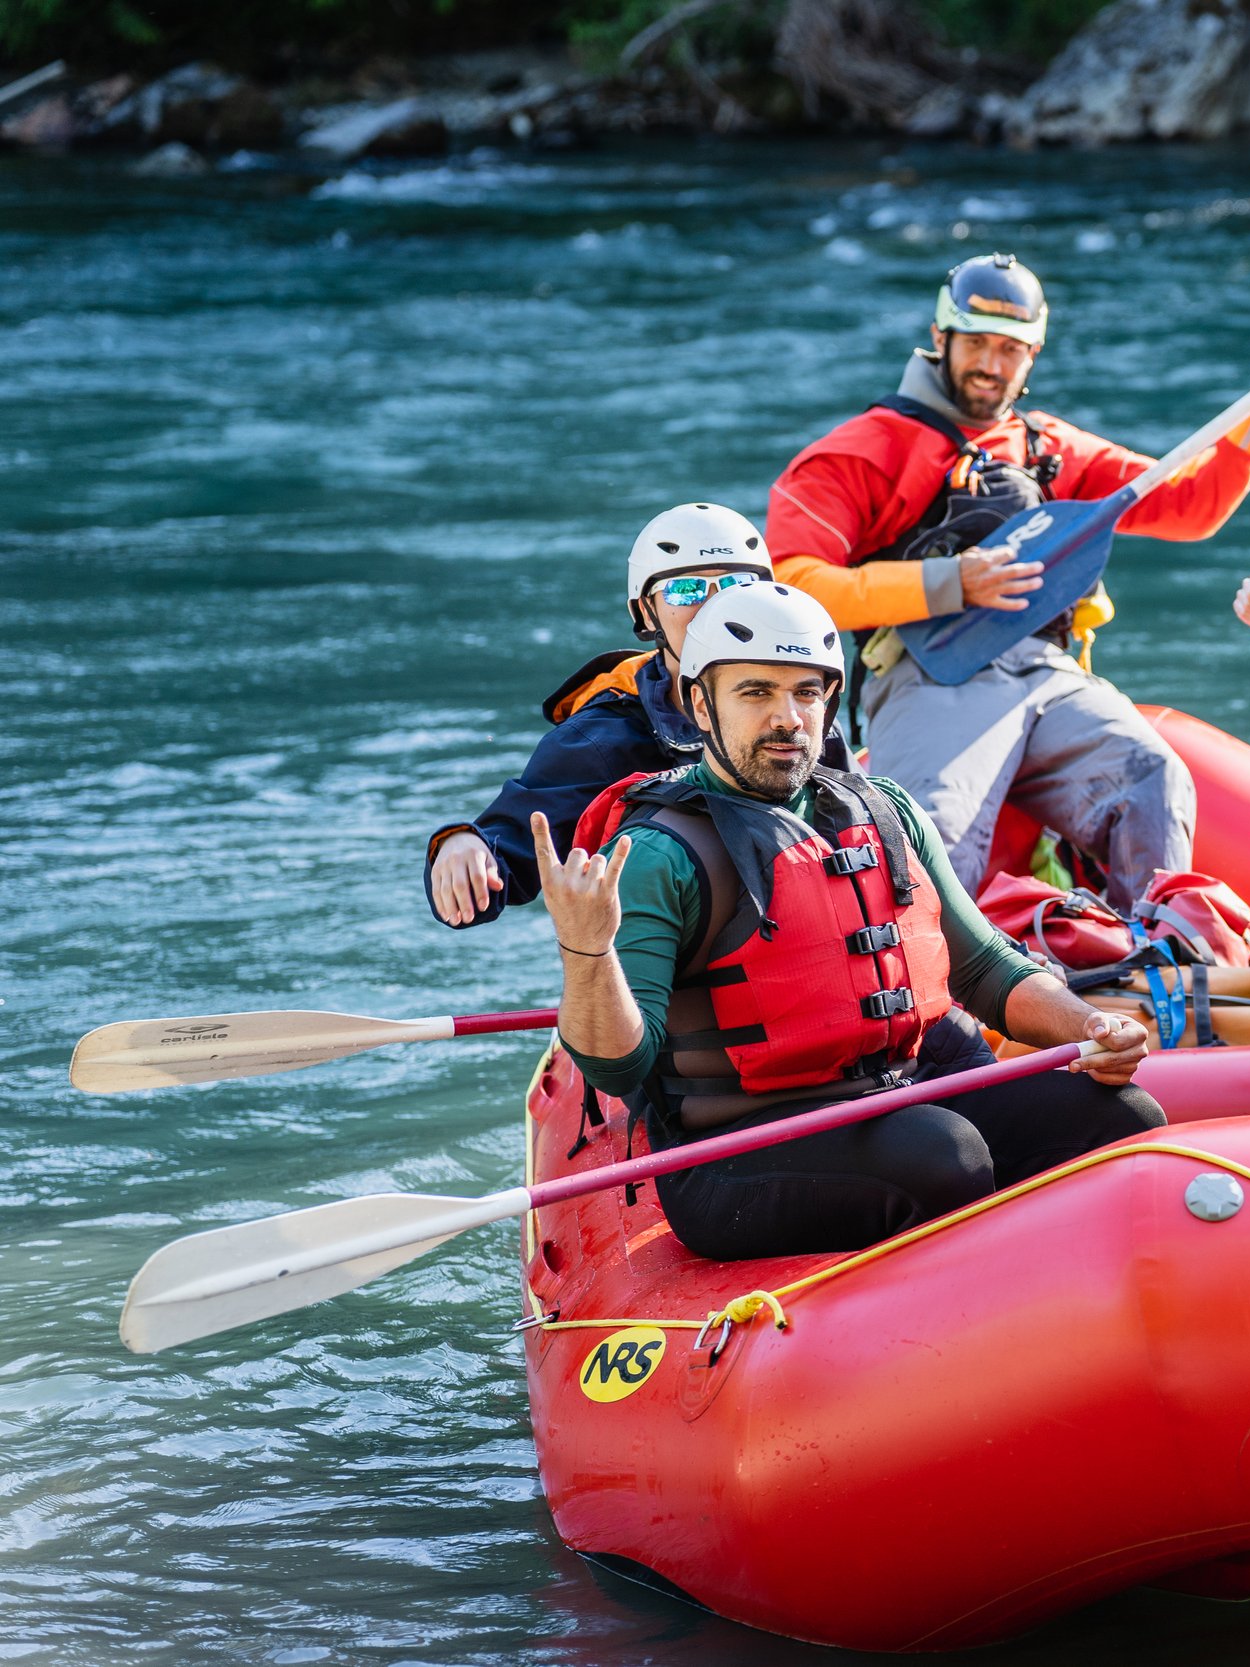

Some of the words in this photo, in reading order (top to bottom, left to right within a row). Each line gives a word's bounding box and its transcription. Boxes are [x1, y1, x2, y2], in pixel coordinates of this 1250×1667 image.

[1006, 509, 1055, 551] RS
[700, 547, 734, 556] NRS
[776, 645, 812, 656] NRS
[160, 1032, 229, 1043] carlisle
[582, 1340, 663, 1384] NRS
